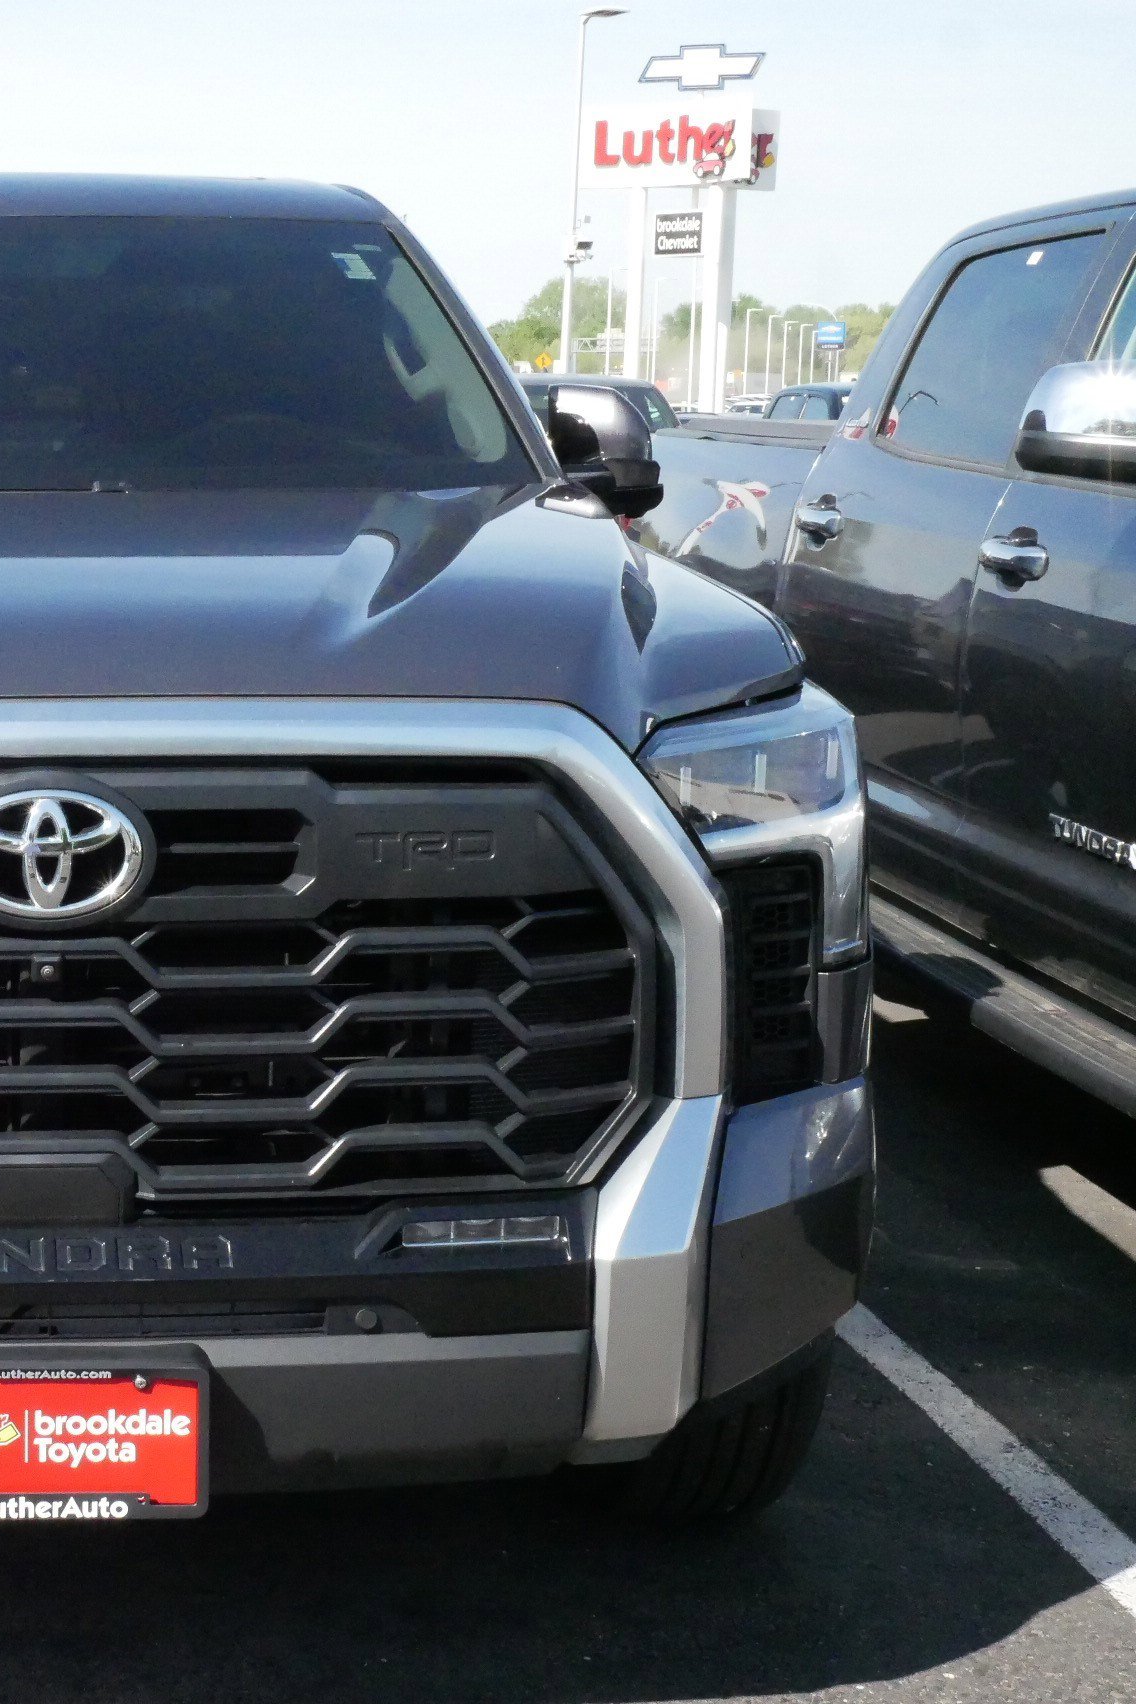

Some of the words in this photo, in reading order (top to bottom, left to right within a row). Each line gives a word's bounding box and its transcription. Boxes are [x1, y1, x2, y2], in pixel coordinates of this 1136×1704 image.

[594, 115, 736, 166] Luther
[657, 217, 701, 233] brookdale
[657, 235, 699, 250] Chevrolet
[355, 830, 496, 871] TRD
[33, 1408, 192, 1437] brookdale
[33, 1437, 137, 1468] Toyota
